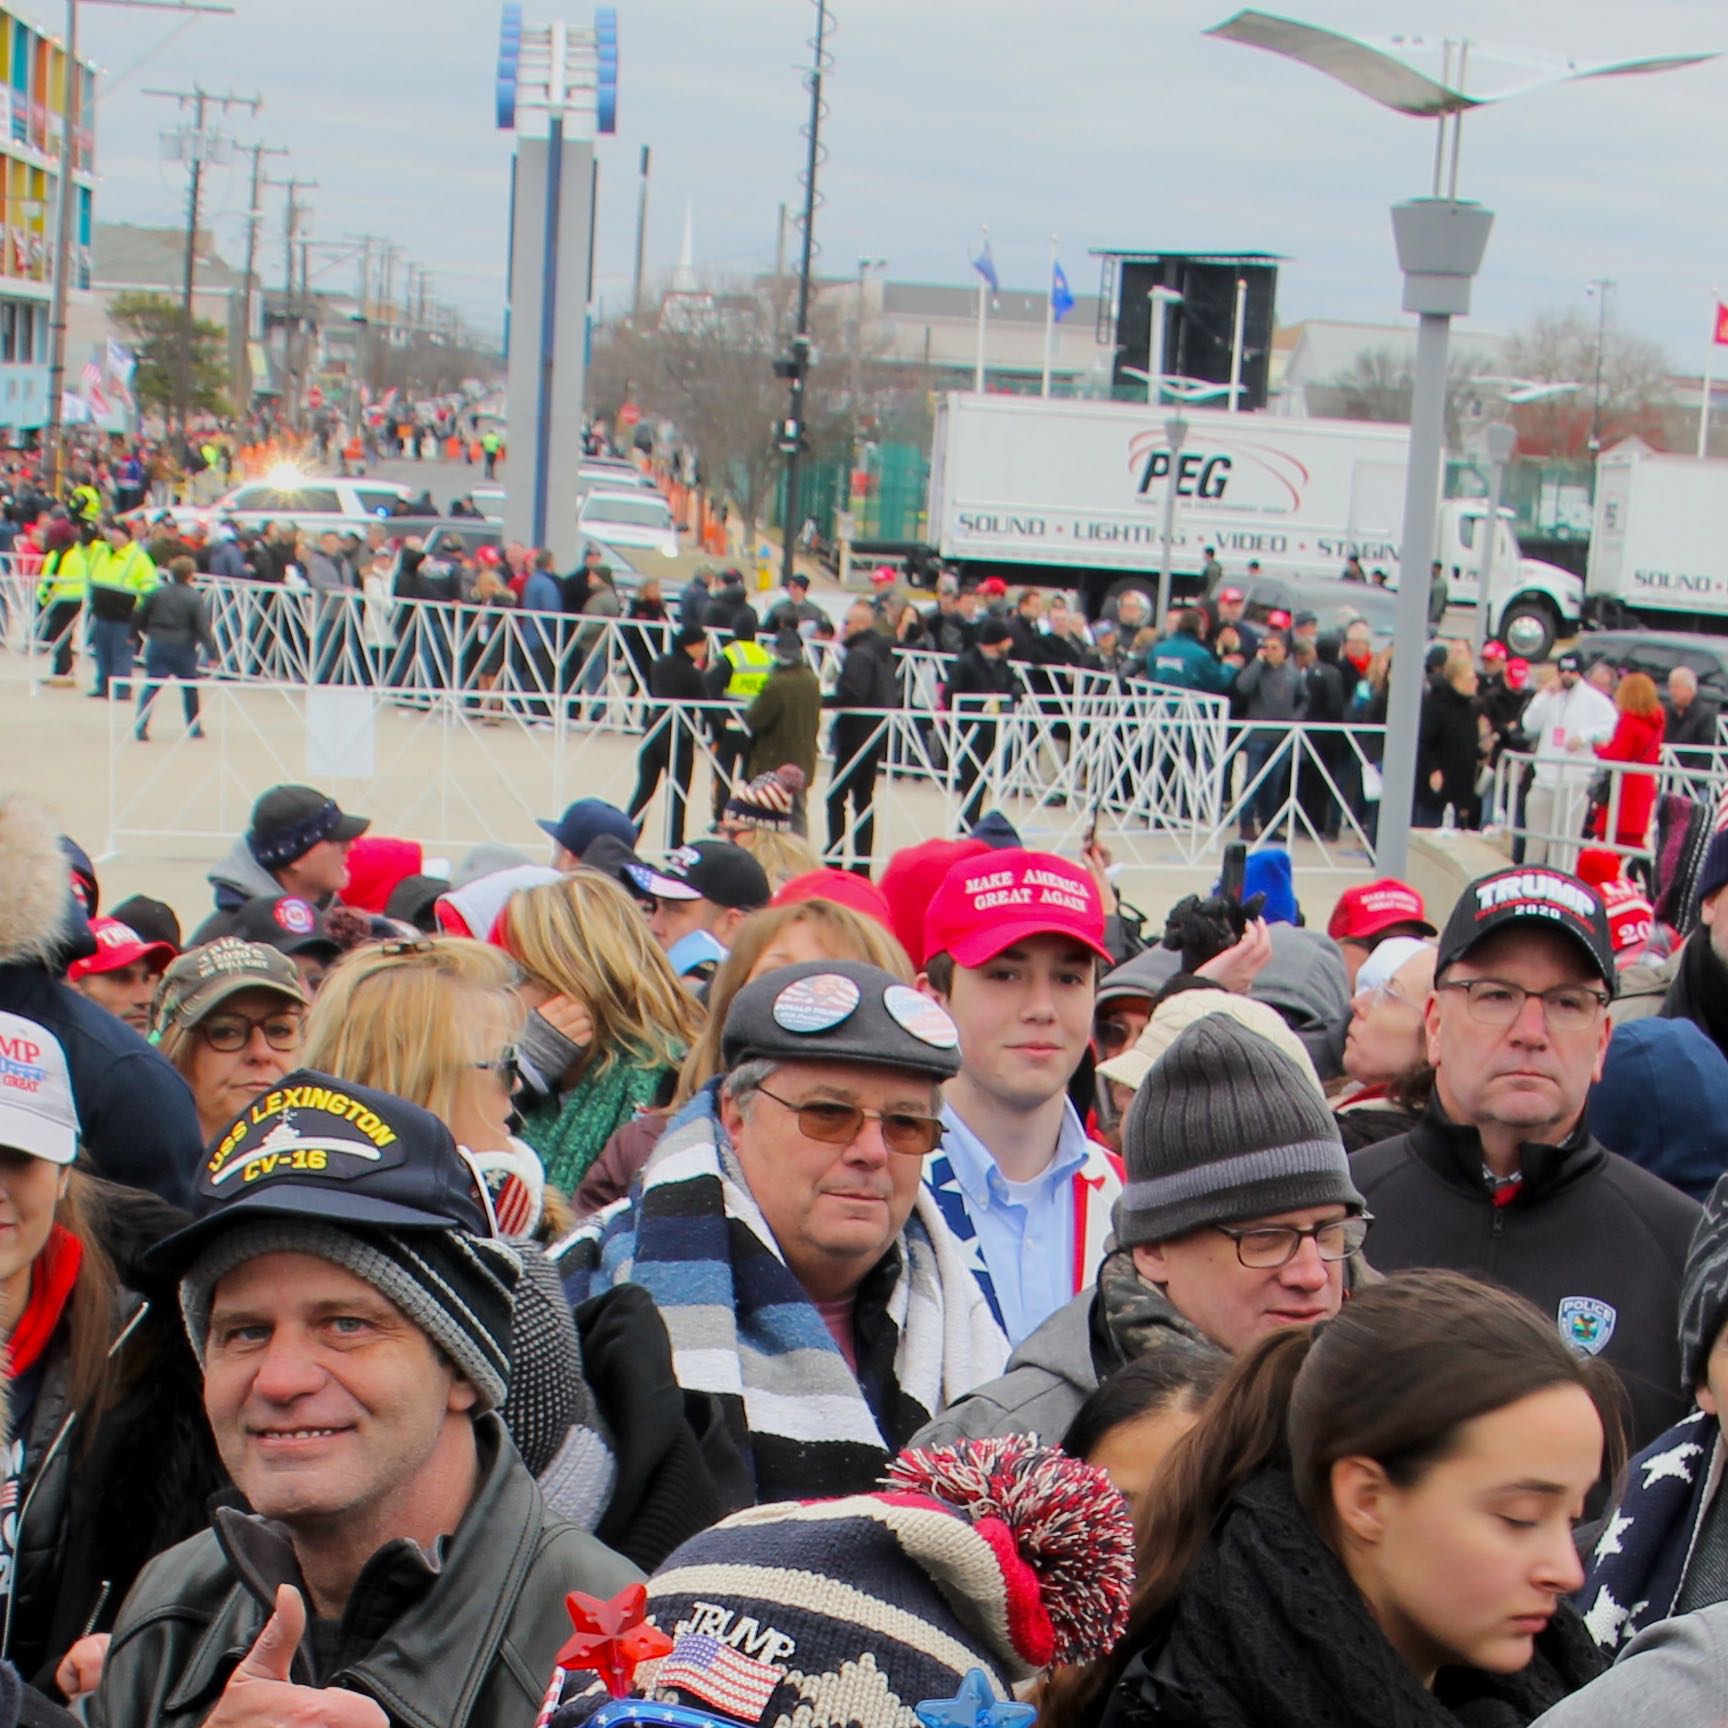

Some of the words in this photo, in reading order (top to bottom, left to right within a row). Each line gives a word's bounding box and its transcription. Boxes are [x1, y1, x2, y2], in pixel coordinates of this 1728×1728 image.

[1138, 451, 1232, 500] PEG
[957, 511, 1046, 538] SOUND
[1073, 520, 1187, 547] LIGHTIG
[1214, 530, 1288, 555] VIDEO
[1316, 537, 1402, 563] STAGIN
[1633, 569, 1711, 594] SOUND
[965, 871, 1013, 895] MAKE
[1021, 867, 1091, 900] AMERICA
[973, 888, 1028, 911] GREAT
[1040, 885, 1088, 914] AGAIN
[1474, 872, 1596, 917] TRUMP
[1514, 904, 1562, 921] 2020
[2, 1076, 40, 1094] GREAT
[207, 1120, 248, 1171] USS
[251, 1085, 397, 1148] LEXINGTON
[242, 1148, 328, 1182] CV-16
[1563, 1301, 1613, 1320] POLICE
[684, 1600, 796, 1663] TRUMP
